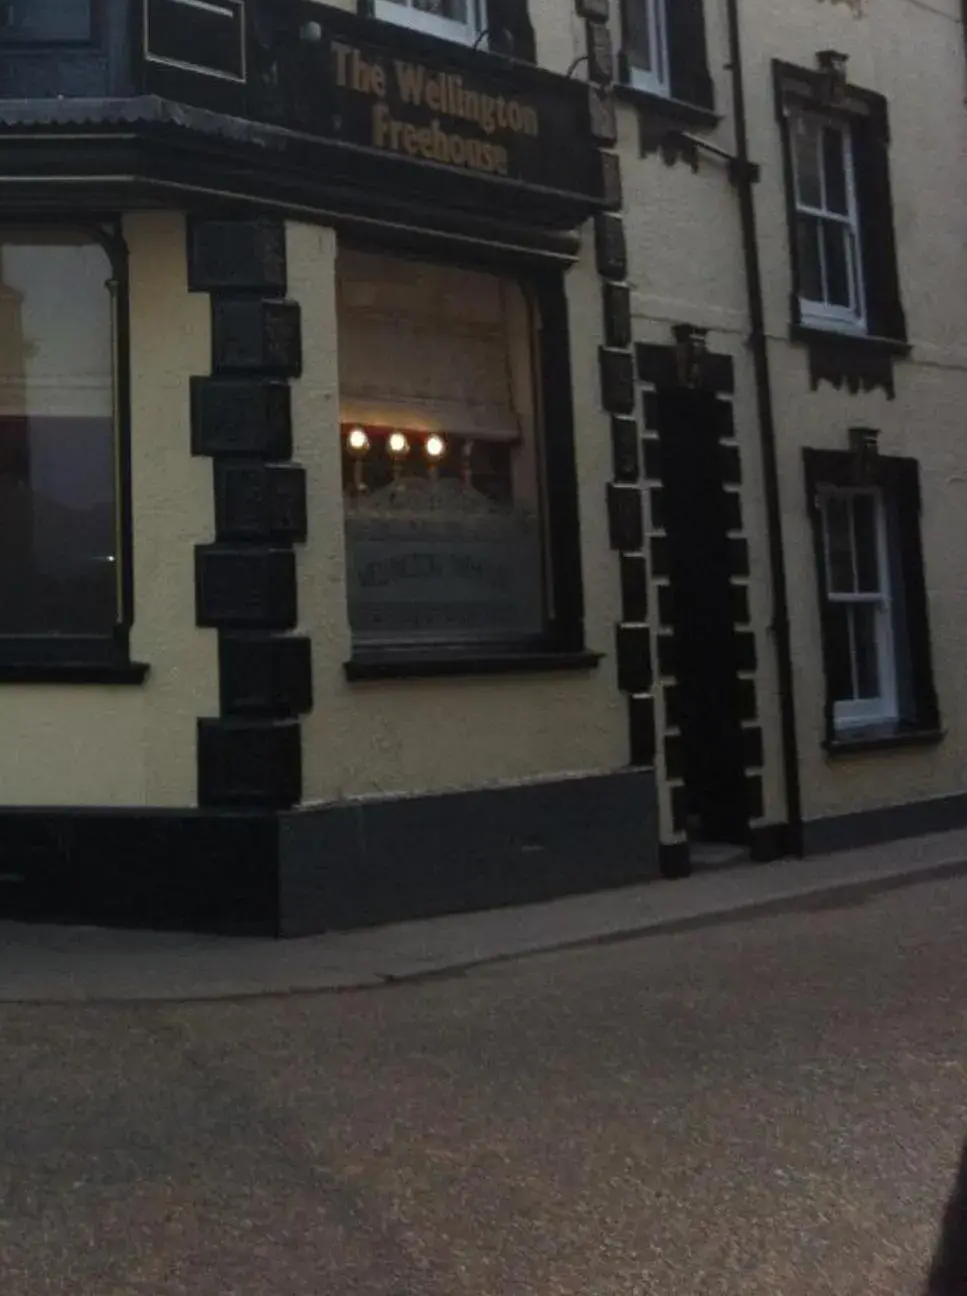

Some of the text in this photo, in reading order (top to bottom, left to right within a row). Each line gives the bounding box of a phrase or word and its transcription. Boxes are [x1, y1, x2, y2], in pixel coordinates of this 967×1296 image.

[330, 39, 539, 137] The Wellington
[371, 103, 508, 176] Freehouse
